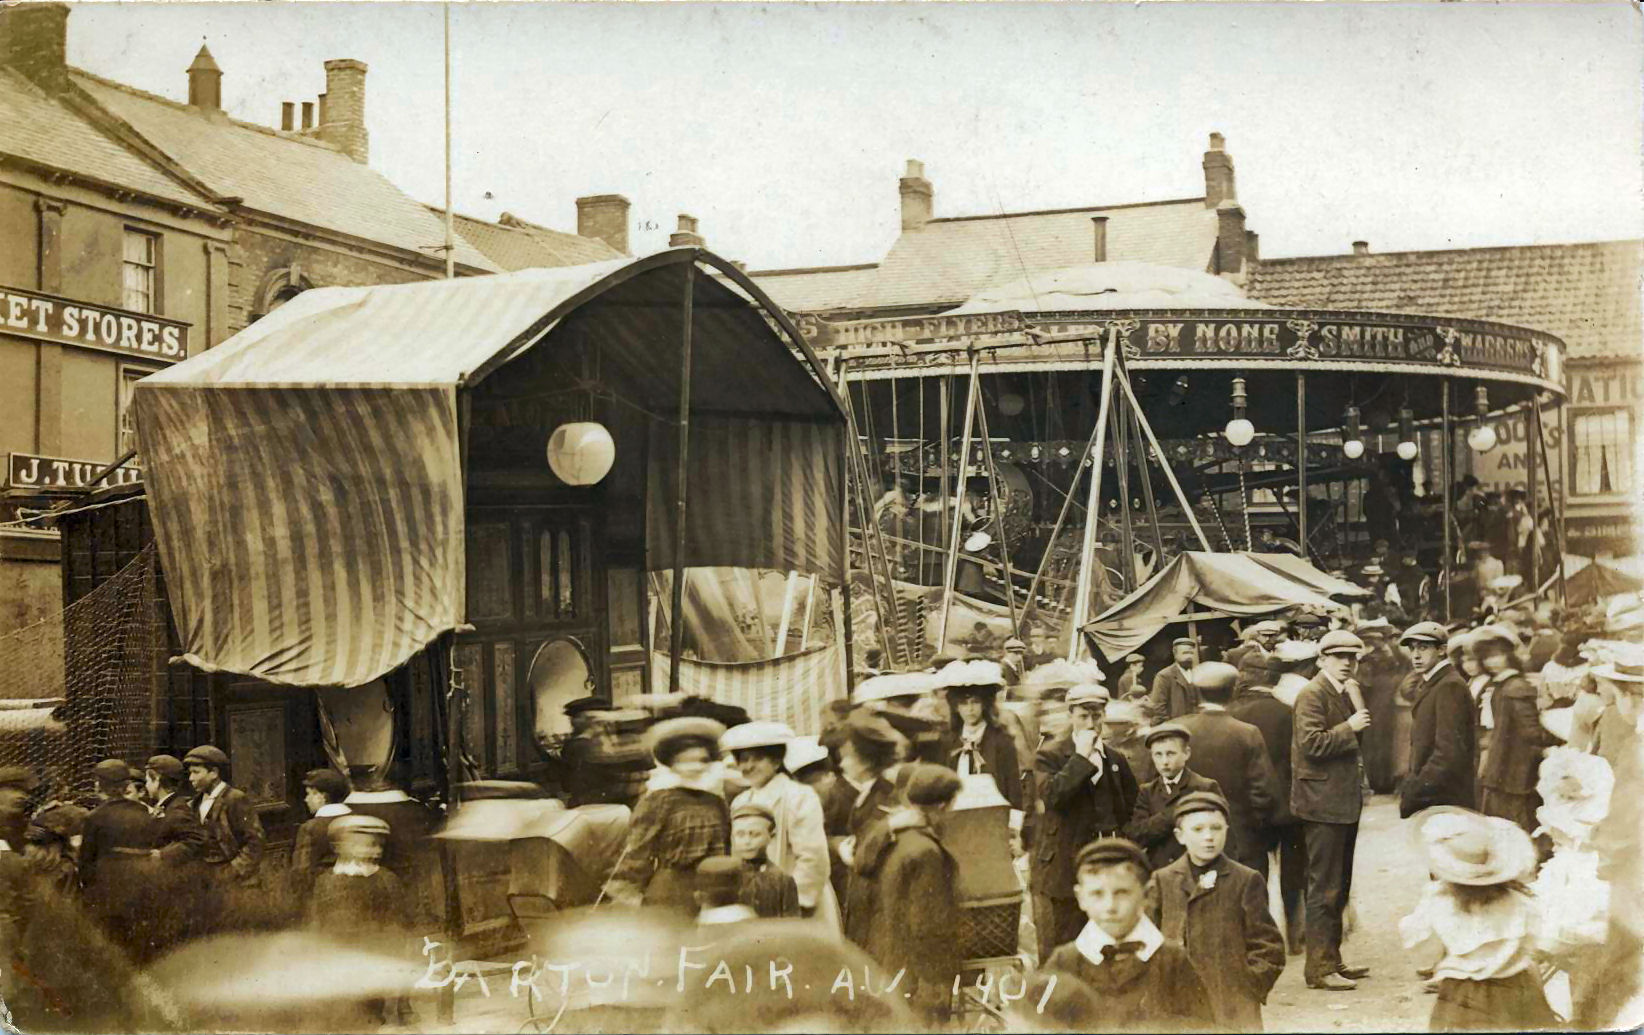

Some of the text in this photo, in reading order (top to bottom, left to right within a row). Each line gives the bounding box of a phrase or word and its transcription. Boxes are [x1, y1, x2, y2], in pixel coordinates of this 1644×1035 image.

[62, 305, 186, 358] STORES.
[1146, 322, 1184, 353] BY
[1194, 322, 1280, 353] NONE
[1319, 325, 1406, 358] SMITH
